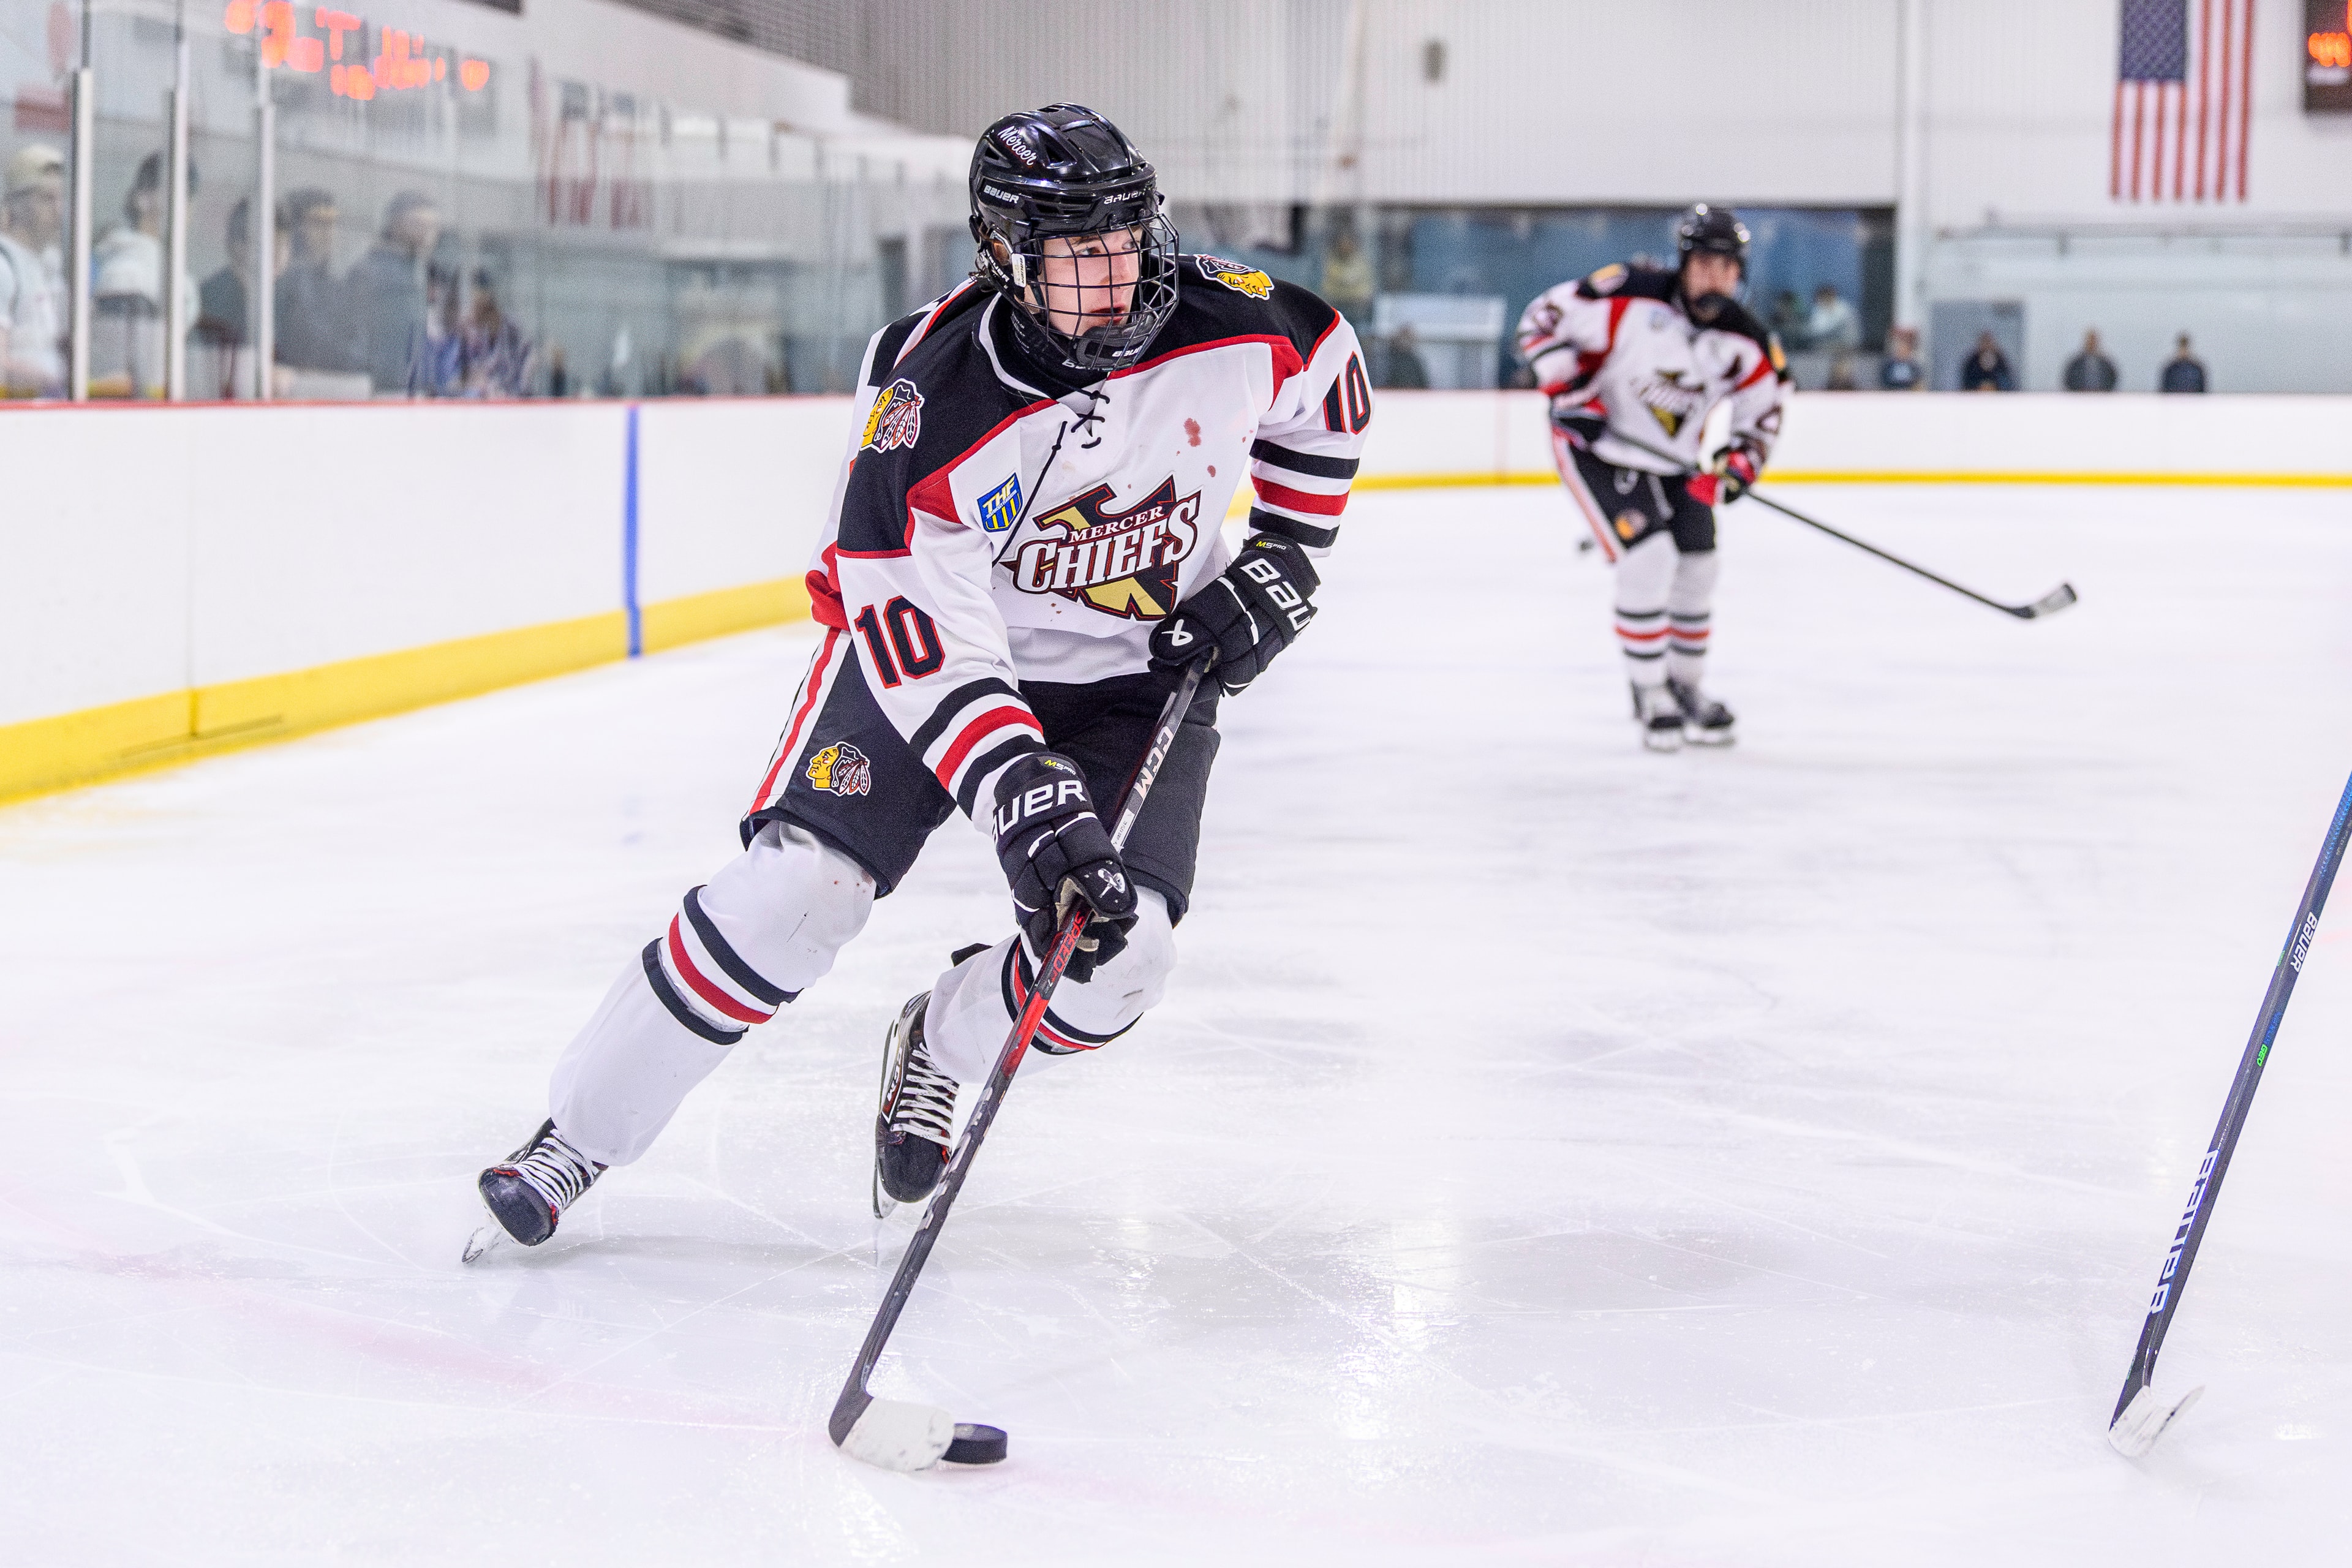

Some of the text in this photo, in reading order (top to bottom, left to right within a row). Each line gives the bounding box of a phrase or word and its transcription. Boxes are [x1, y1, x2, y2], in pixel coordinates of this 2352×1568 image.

[997, 126, 1037, 165] Mercer
[983, 184, 1019, 203] BAUER
[1323, 350, 1371, 435] 10
[982, 475, 1015, 514] THF
[1068, 506, 1164, 543] MERCER
[1017, 497, 1198, 592] CHIEFS
[1239, 558, 1311, 631] BAU
[854, 595, 946, 689] 10
[1133, 726, 1173, 800] CCM
[992, 780, 1087, 843] UER
[1054, 911, 1085, 973] SPEED
[2290, 911, 2318, 973] BAUER
